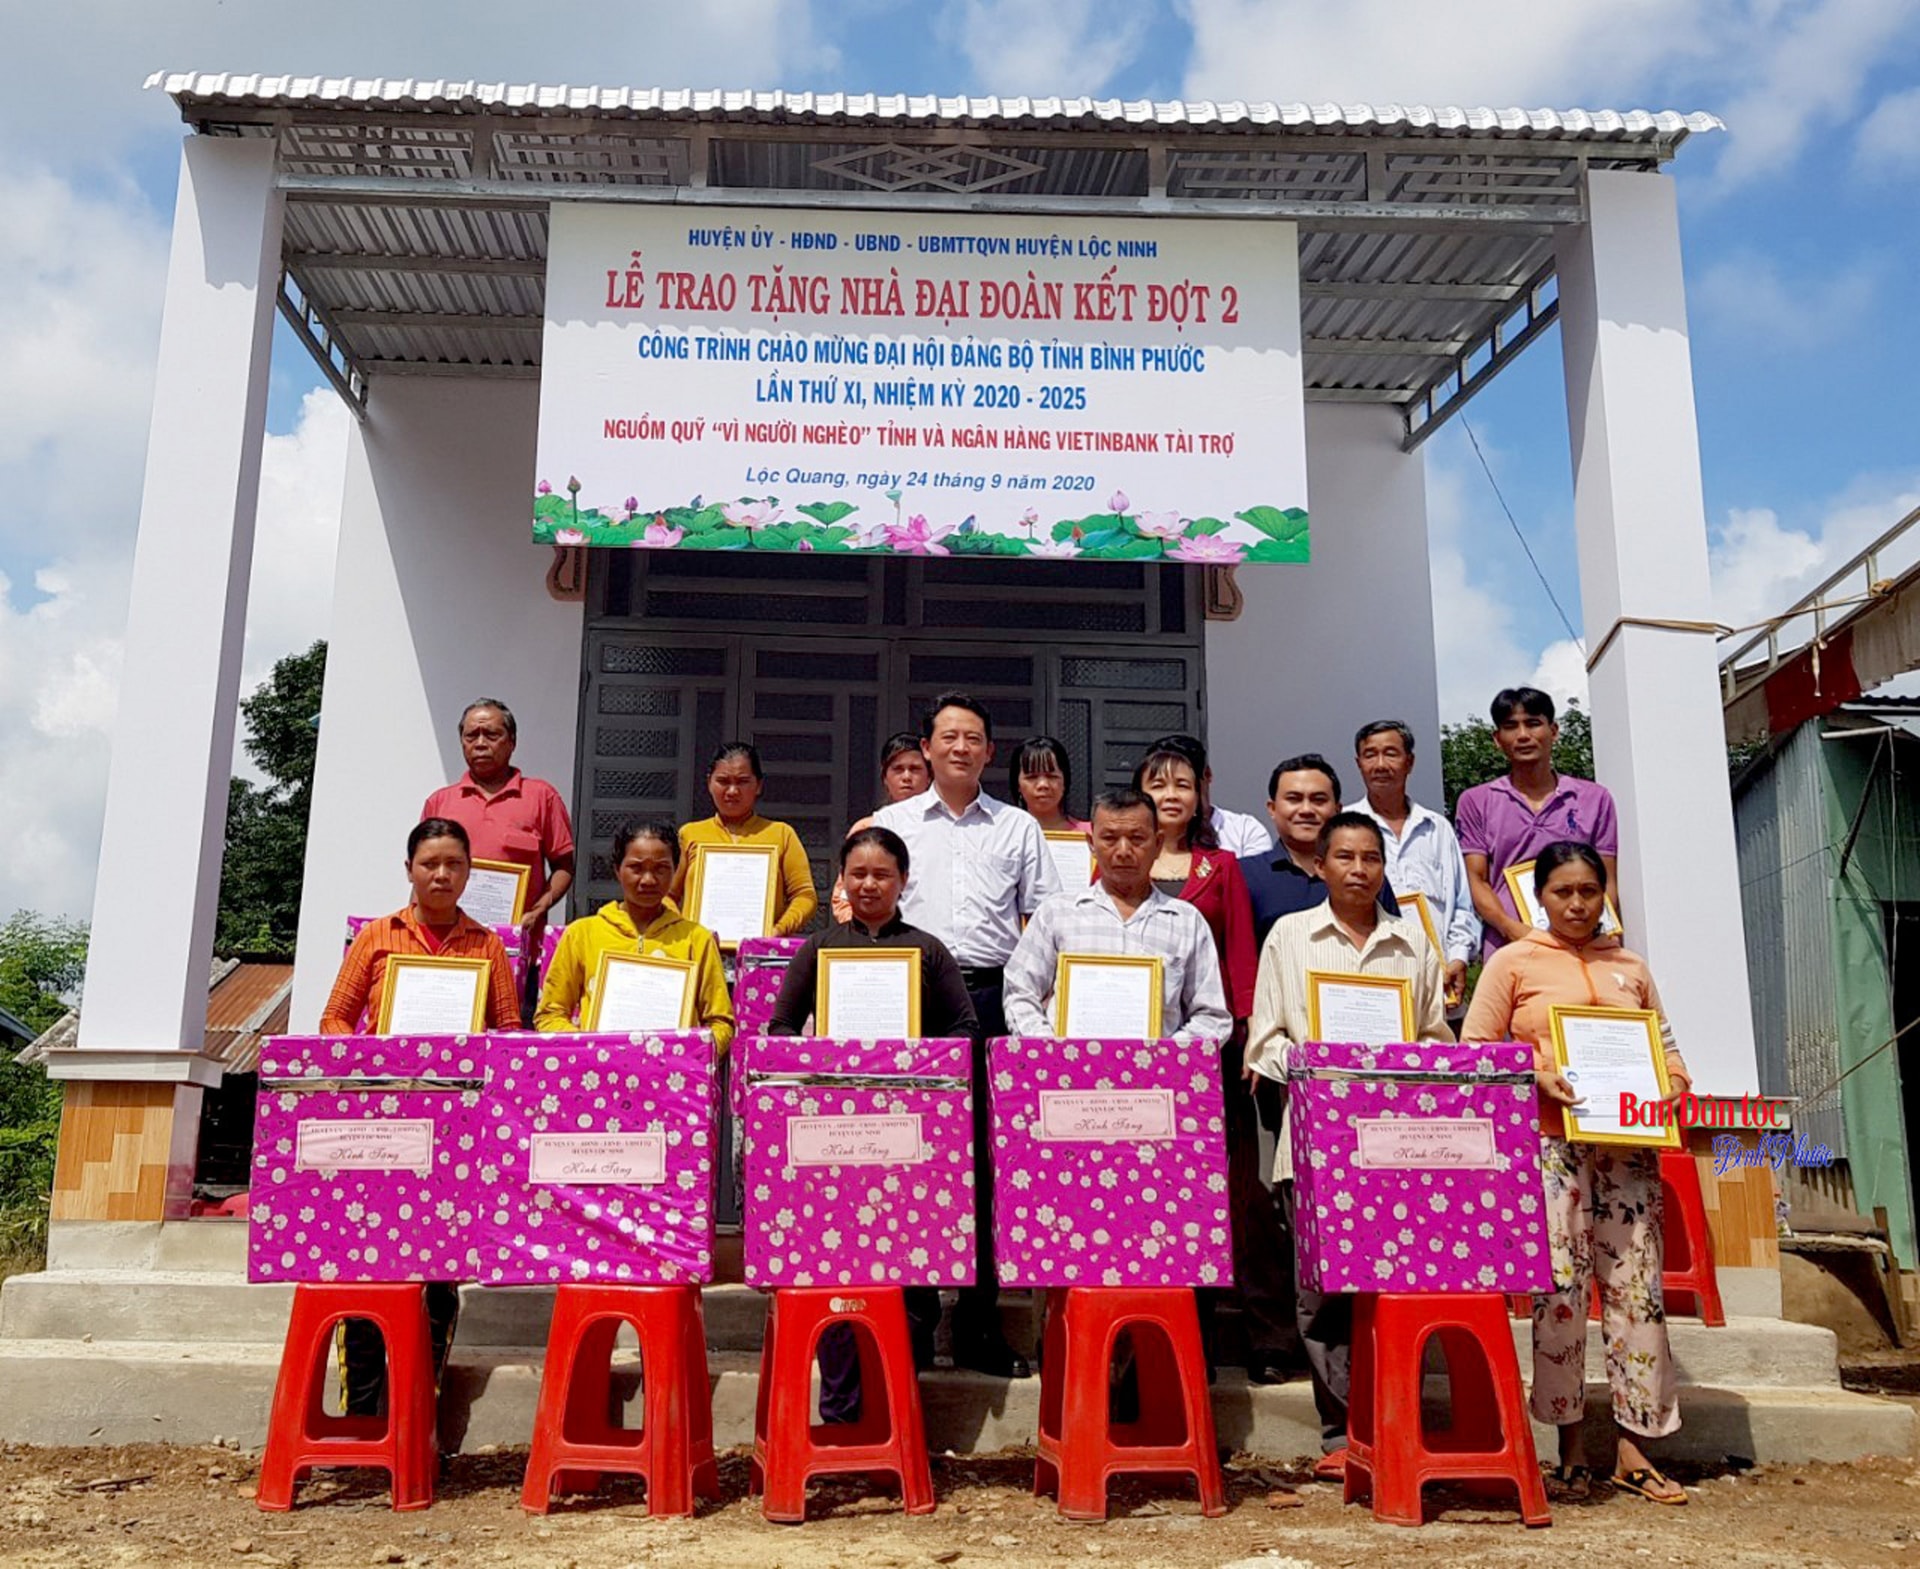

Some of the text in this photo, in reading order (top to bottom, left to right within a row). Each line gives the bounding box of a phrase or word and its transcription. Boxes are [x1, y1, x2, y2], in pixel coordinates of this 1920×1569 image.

[689, 226, 745, 250] HUYỆN
[751, 225, 773, 249] ỦY
[791, 232, 837, 250] HĐND
[855, 234, 900, 251] UBND
[918, 237, 1010, 258] UBMTTQVN
[1016, 234, 1072, 258] HUYỆN
[1079, 237, 1111, 259] LỘC
[1118, 241, 1157, 257] NINH
[606, 250, 1239, 332] LỄ TRAO TẶNG NHÀ ĐẠI ĐOÀN KẾT ĐỢT 2
[639, 329, 1204, 374] CÔNG TRÌNH CHÀO MỪNG ĐẠI HỘI ĐẢNG BỘ TỈNH BÌNH PHƯỚC
[756, 369, 793, 403] LẦN
[800, 374, 838, 405] THỨ
[844, 381, 867, 409] XI,
[874, 377, 934, 411] NHIỆM
[941, 380, 965, 407] KỲ
[974, 385, 1020, 409] 2020
[1039, 386, 1086, 410] 2025
[604, 412, 665, 441] NGUỒM
[671, 414, 705, 442] QUỸ
[745, 419, 796, 444] NGƯỜI
[877, 418, 916, 446] TỈNH
[922, 423, 945, 447] VÀ
[952, 424, 997, 449] NGÂN
[1004, 426, 1050, 450] HÀNG
[1056, 432, 1158, 452] VIETINBANK
[1165, 429, 1193, 453] TÀI
[1199, 432, 1235, 457] TRỢ
[746, 467, 1095, 492] Lộc Quang, ngày 24 tháng 9 năm 2020
